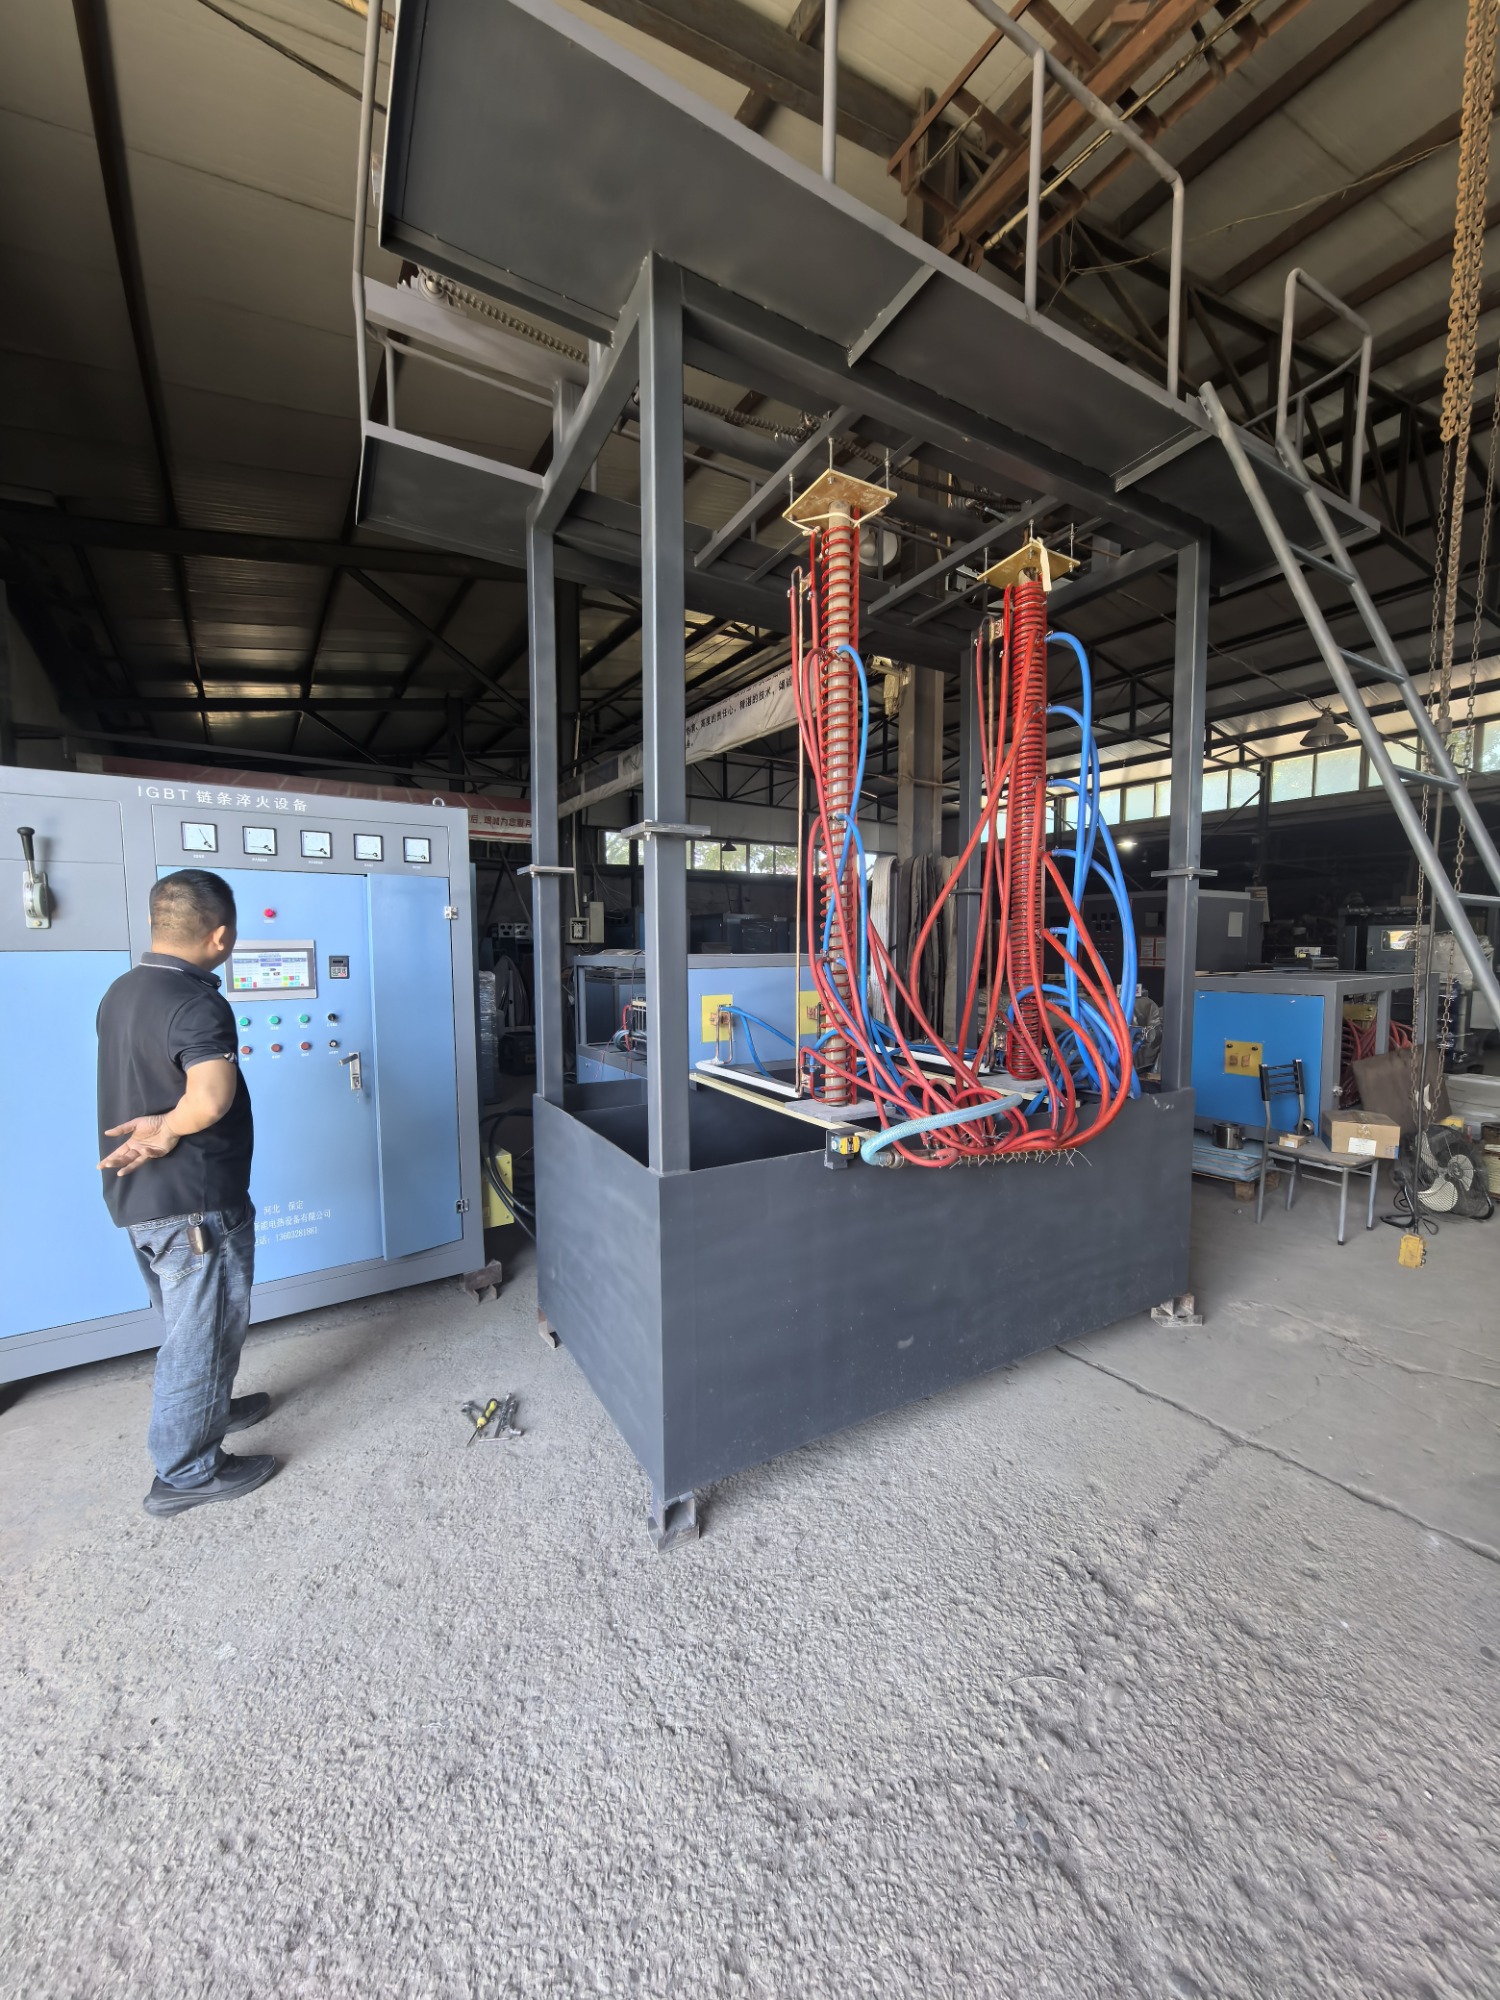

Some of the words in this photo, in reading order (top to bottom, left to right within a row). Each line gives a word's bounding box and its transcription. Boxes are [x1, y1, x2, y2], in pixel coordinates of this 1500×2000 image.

[138, 785, 189, 801] IGBT
[196, 790, 307, 812] 链条淬火设备
[263, 1203, 281, 1215] 河北
[288, 1200, 304, 1211] 保定
